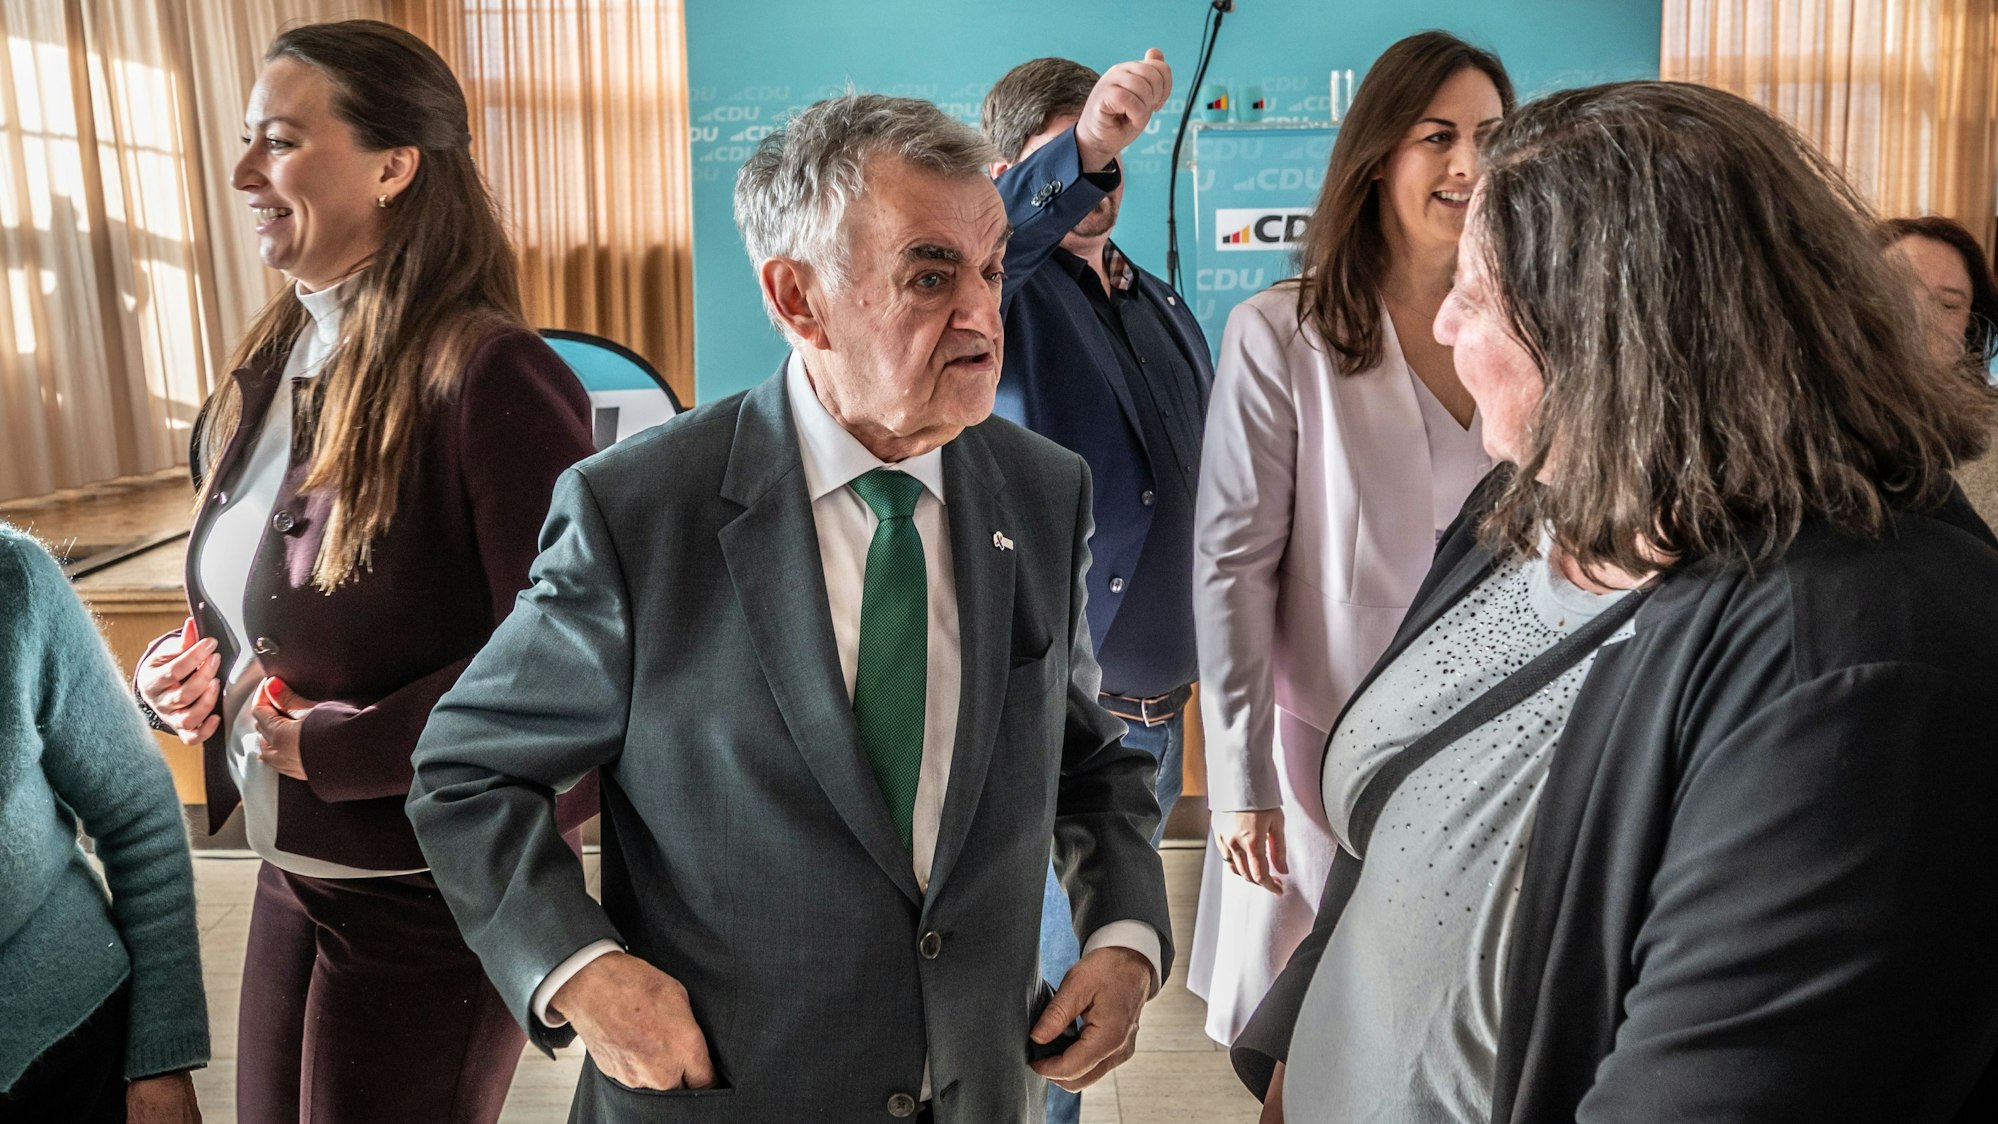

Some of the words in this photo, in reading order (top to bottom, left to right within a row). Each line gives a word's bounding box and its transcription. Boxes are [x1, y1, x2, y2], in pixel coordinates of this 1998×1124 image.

[713, 106, 760, 121] CDU
[745, 126, 781, 141] CD
[1198, 268, 1264, 291] CDU
